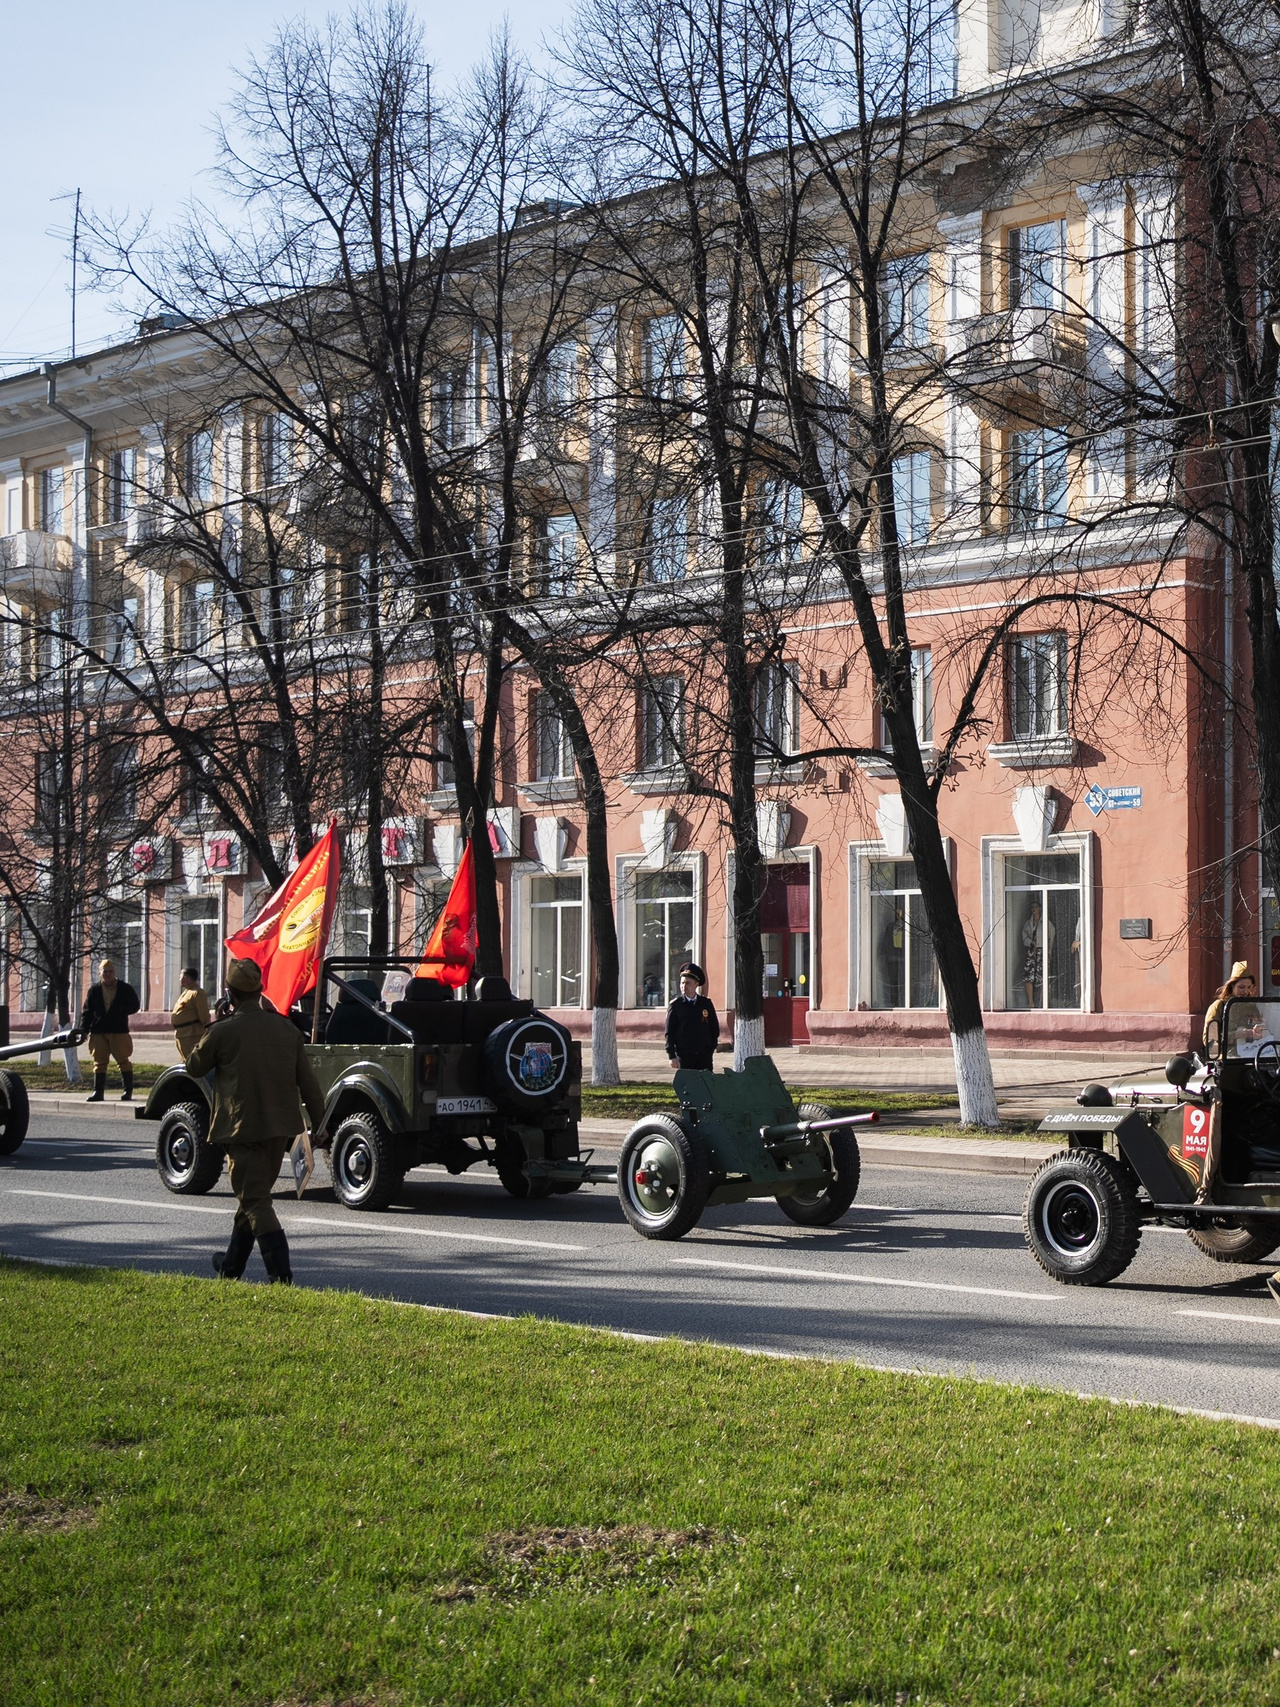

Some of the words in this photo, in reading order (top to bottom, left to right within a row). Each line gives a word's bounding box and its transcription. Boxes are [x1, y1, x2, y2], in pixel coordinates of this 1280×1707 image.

[1108, 787, 1140, 797] СОВЕТСКИЙ
[442, 1103, 454, 1111] АО
[457, 1099, 482, 1111] 1941
[1050, 1113, 1079, 1123] ДНЁМ
[1190, 1110, 1205, 1133] 9
[1186, 1135, 1207, 1145] МАЯ
